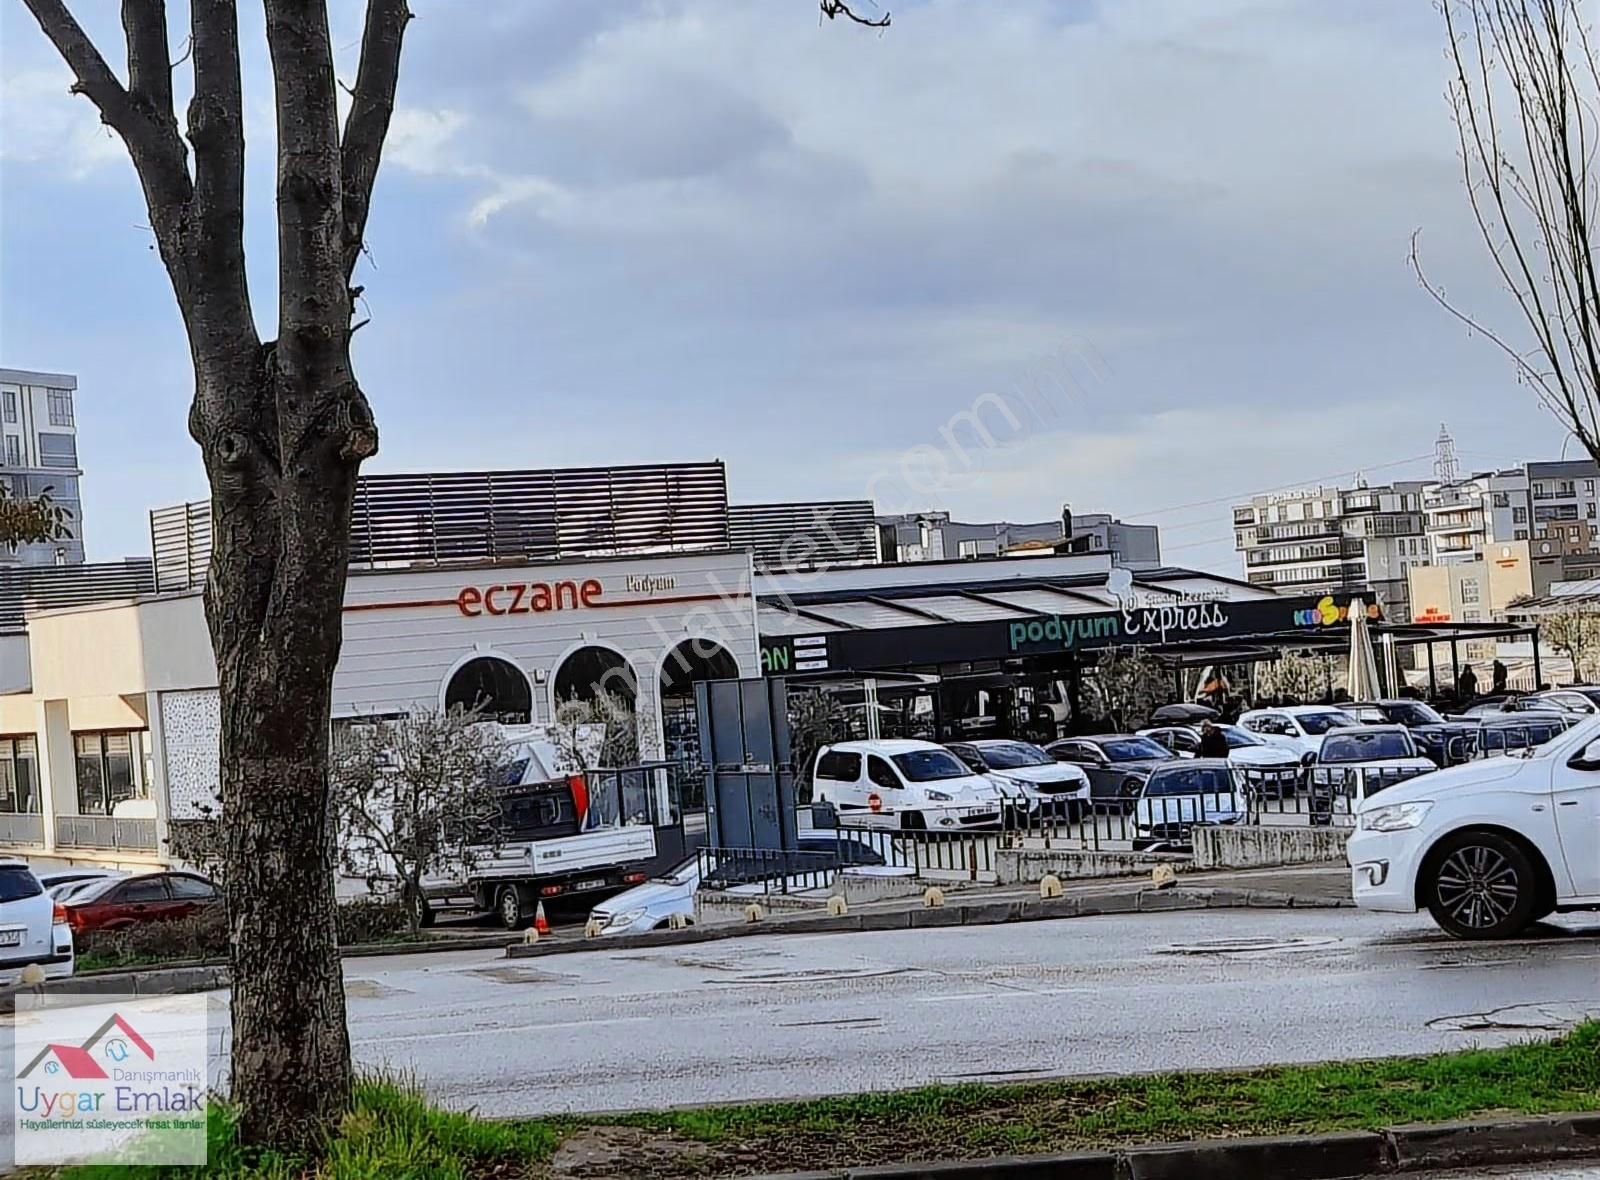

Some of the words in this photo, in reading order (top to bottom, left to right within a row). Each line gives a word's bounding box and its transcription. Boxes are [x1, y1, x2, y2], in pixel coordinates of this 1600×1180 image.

[457, 578, 604, 617] eczane
[1009, 614, 1119, 650] podyum
[1121, 602, 1229, 643] Express
